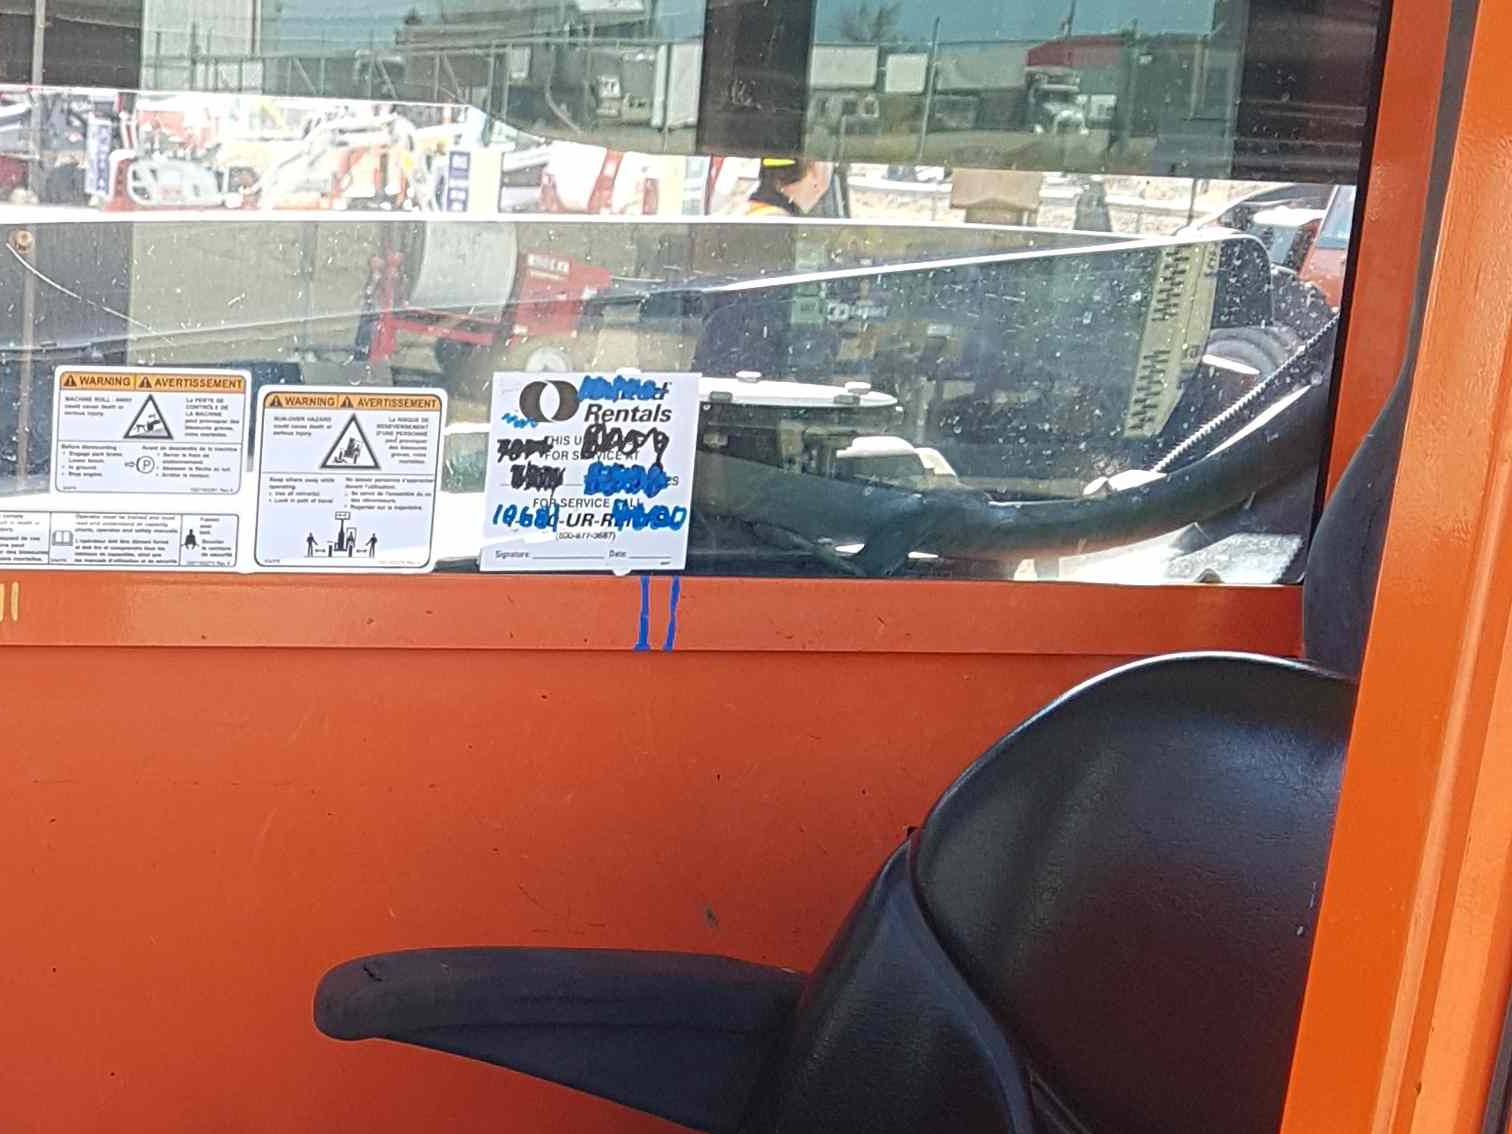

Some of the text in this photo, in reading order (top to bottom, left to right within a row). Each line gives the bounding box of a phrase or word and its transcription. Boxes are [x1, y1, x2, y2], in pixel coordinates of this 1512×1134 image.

[80, 377, 131, 386] WARNING
[154, 378, 242, 388] AVERTISSEMENT
[285, 397, 335, 407] WARNING
[357, 398, 436, 408] AVERTISSEMENT
[584, 404, 672, 423] Rentals
[560, 498, 610, 508] SERVICE
